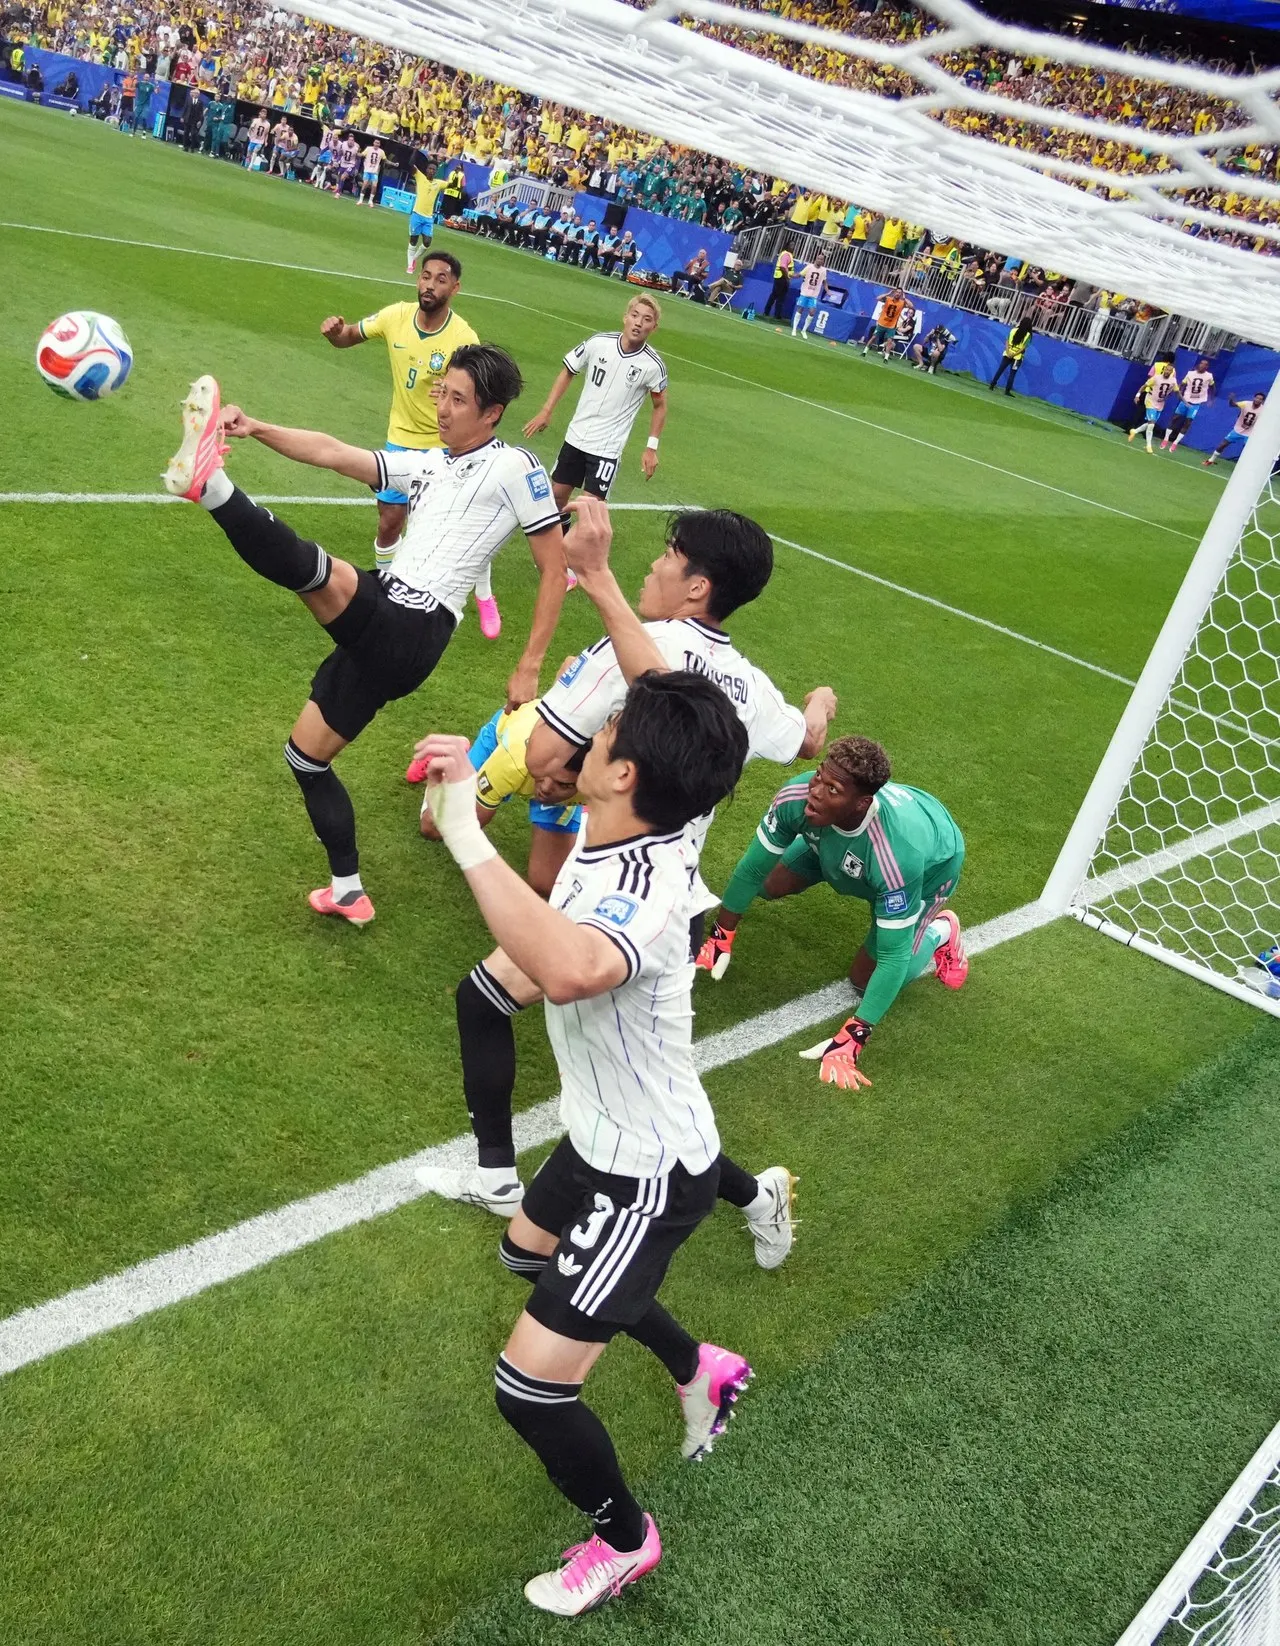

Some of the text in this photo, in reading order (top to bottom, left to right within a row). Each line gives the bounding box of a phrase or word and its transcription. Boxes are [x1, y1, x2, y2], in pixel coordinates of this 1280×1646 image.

[406, 367, 418, 389] 9
[591, 365, 607, 388] 10
[595, 459, 616, 483] 10
[408, 480, 430, 515] 21
[569, 1191, 615, 1250] 3
